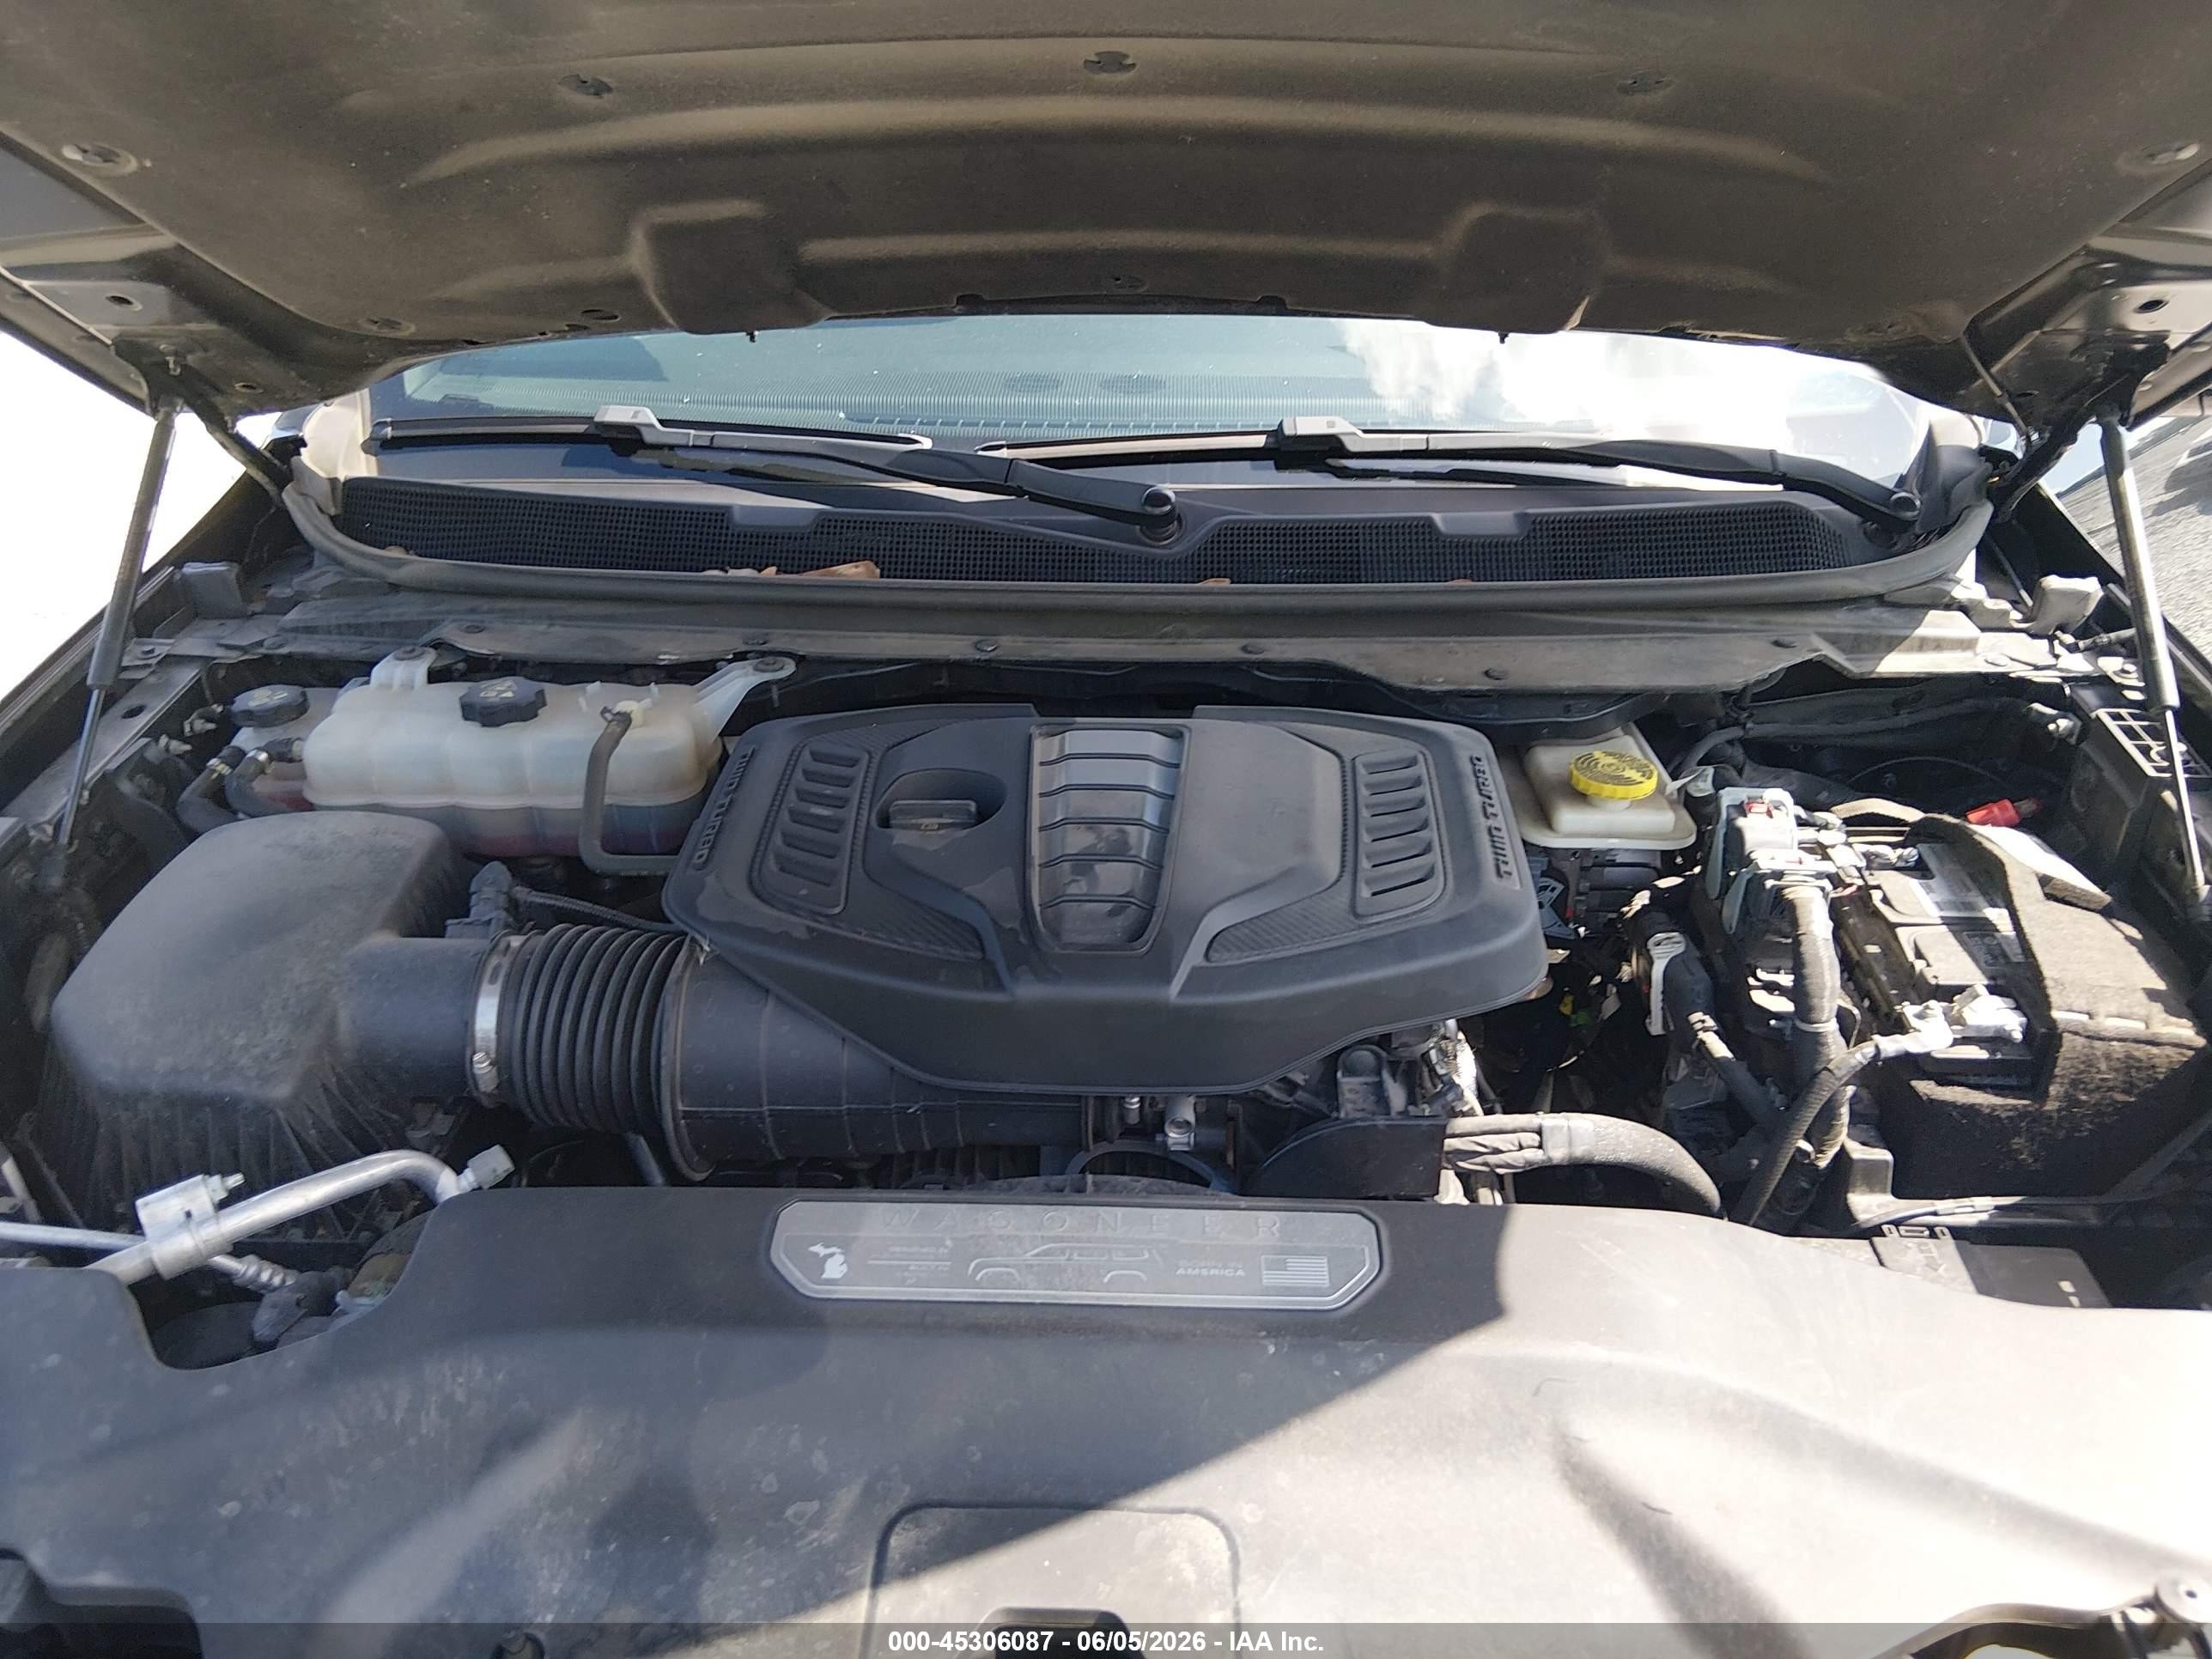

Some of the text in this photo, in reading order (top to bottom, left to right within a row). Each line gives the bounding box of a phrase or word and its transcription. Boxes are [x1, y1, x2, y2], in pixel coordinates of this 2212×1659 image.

[694, 794, 732, 866] TURBO
[883, 1209, 1281, 1238] WAGONEER
[1175, 1267, 1247, 1277] AMERICA
